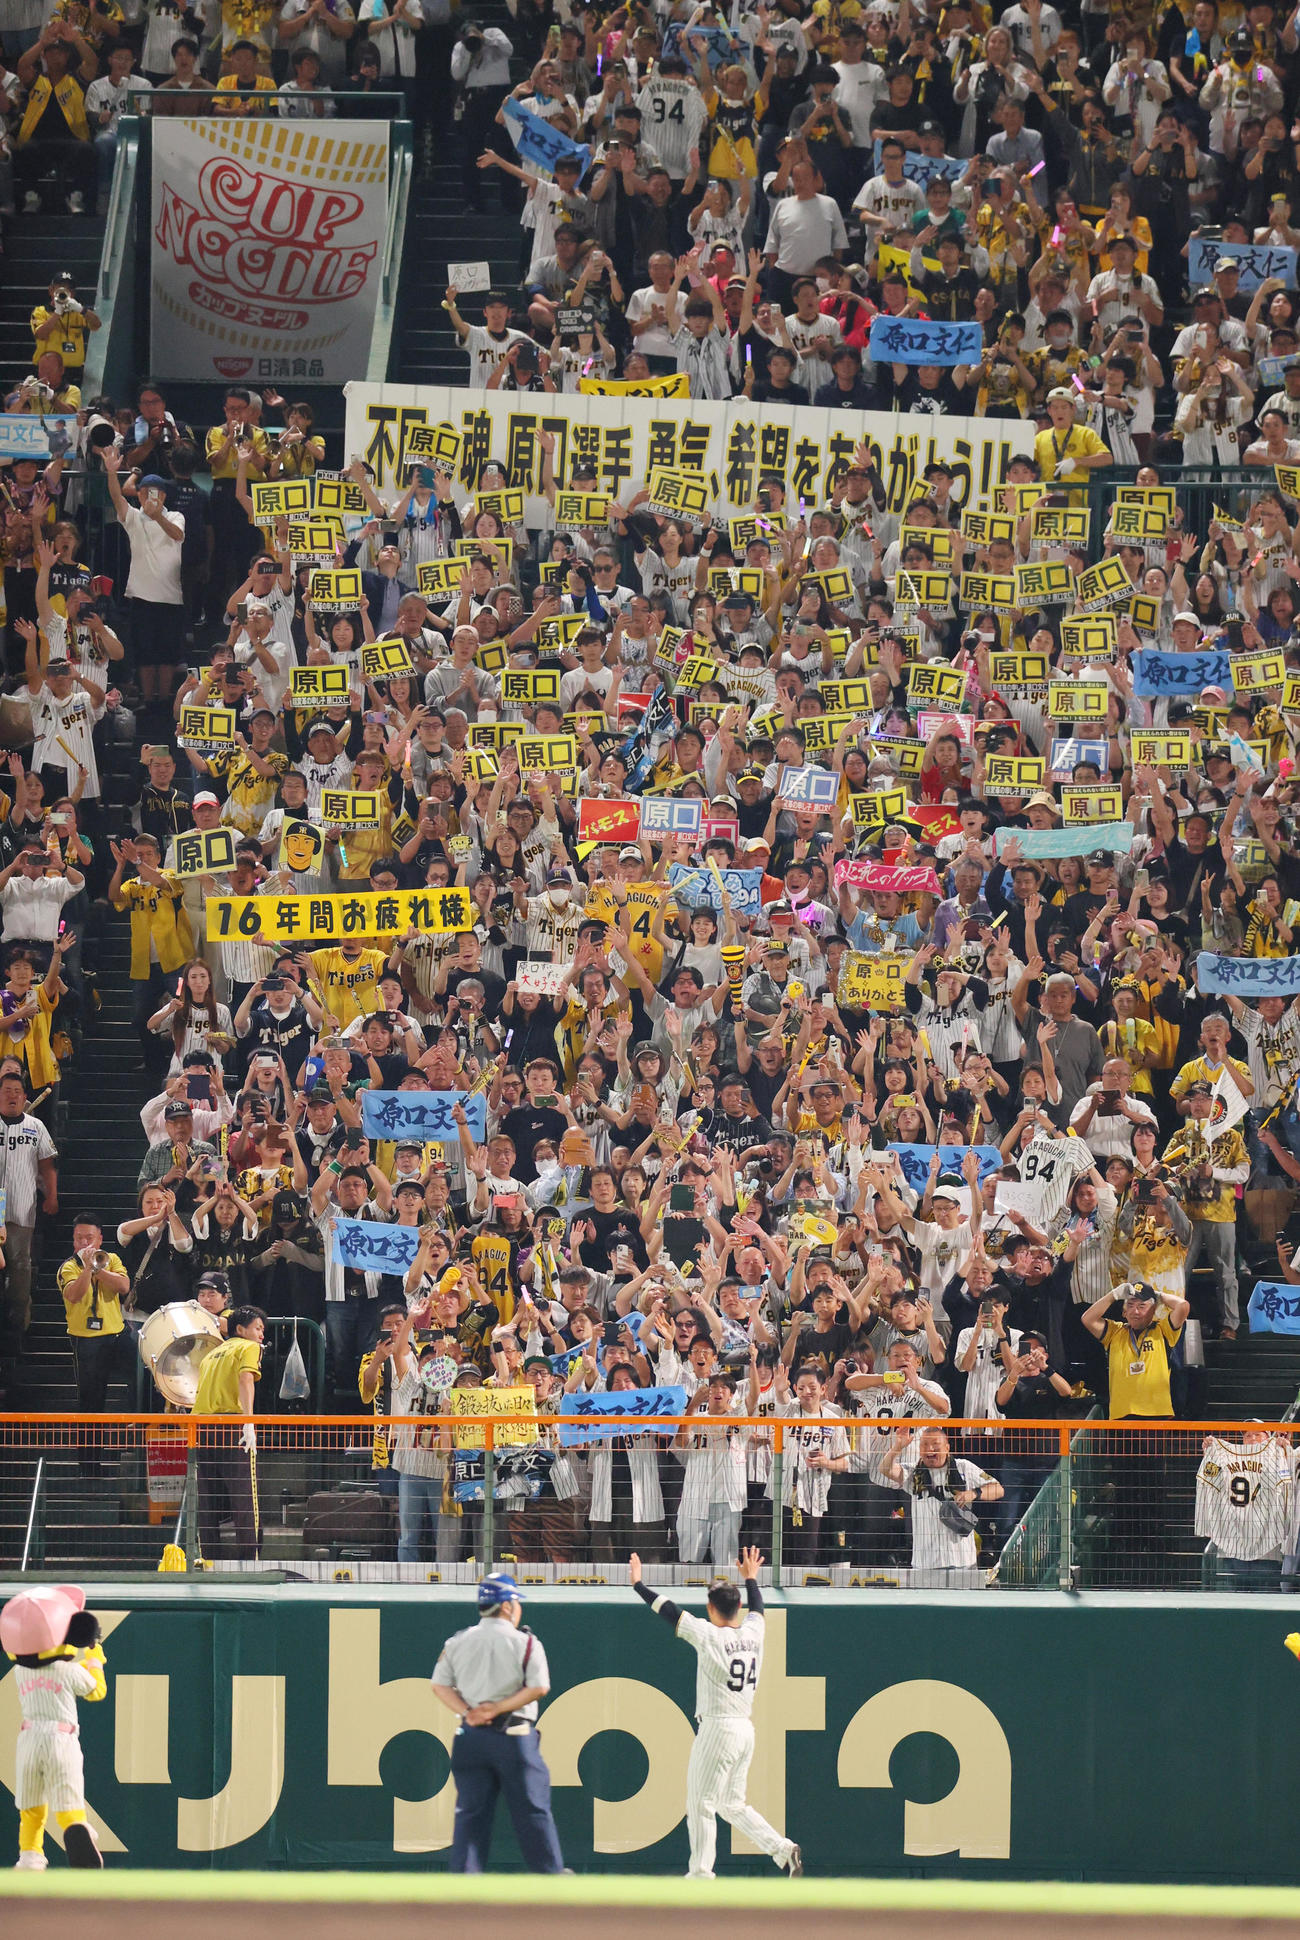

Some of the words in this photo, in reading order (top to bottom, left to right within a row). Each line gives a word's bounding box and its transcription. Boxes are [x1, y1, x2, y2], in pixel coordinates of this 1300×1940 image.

[652, 97, 685, 123] 94
[198, 157, 364, 245] CUP
[156, 182, 378, 304] NOODLE
[196, 288, 303, 328] カップヌードル
[878, 322, 976, 356] 原口文仁
[260, 357, 324, 377] 日清食品
[366, 404, 493, 493] 不魂
[507, 412, 632, 500] 原口選手
[408, 424, 460, 458] 原口
[256, 486, 307, 513] 原口
[654, 476, 708, 510] 原口
[557, 495, 608, 521] 原口
[1115, 507, 1168, 533] 原口
[288, 524, 332, 550] 原口
[965, 513, 1014, 541] 原口
[1034, 511, 1088, 537] 原口
[312, 573, 359, 598] 原口
[898, 575, 949, 601] 原口
[963, 578, 1016, 604] 原口
[1018, 563, 1072, 592] 原口
[1080, 562, 1128, 599] 原口
[1063, 627, 1109, 652] 原口
[363, 643, 409, 675] 原口
[994, 655, 1047, 681] 原口
[1142, 657, 1231, 686] 原口文仁
[292, 669, 347, 695] 原口
[679, 660, 719, 686] 原口
[913, 671, 962, 698] 原口
[1236, 662, 1280, 687] 原口
[503, 674, 558, 700] 原口
[821, 683, 871, 710] 原口
[1055, 691, 1102, 712] 原口
[184, 708, 234, 736] 原口
[521, 742, 572, 767] 原口
[1139, 741, 1184, 761] 原口
[988, 758, 1044, 784] 原口
[787, 771, 838, 801] 原口
[324, 793, 377, 820] 原口
[643, 801, 700, 830] 原口
[854, 793, 904, 823] 原口
[1069, 797, 1117, 819] 原口
[177, 830, 235, 874] 原口
[604, 892, 661, 908] HAAGUCH
[217, 893, 465, 936] 16年間お疲れ様
[539, 918, 578, 941] Tiger
[328, 969, 375, 988] Tigers
[926, 1008, 970, 1029] Tigers
[1026, 1154, 1057, 1184] 94
[340, 1225, 418, 1267] 原口文
[478, 1266, 509, 1297] 94
[1257, 1286, 1300, 1323] 原口
[1227, 1460, 1263, 1475] HARAGUC
[728, 1656, 758, 1693] 94
